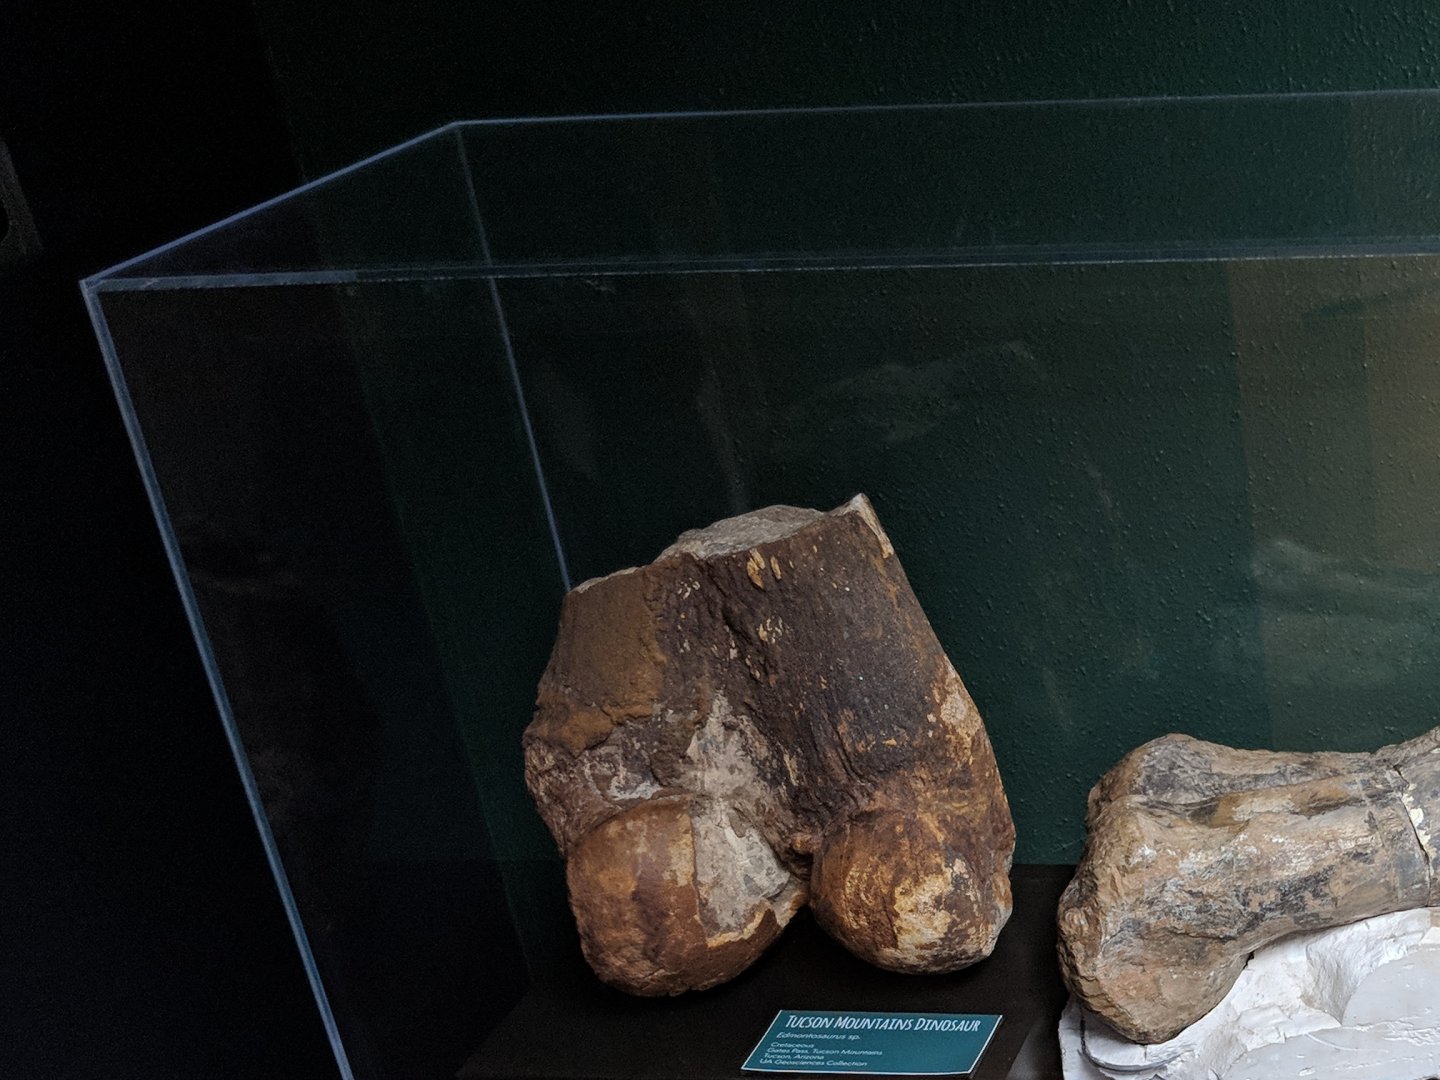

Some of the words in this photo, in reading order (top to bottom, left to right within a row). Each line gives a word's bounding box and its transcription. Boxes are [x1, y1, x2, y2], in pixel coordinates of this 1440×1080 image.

[785, 1015, 835, 1029] TUCSON
[833, 1016, 914, 1030] MOUNTAINS
[913, 1018, 981, 1032] DINOSAUR
[776, 1031, 847, 1040] Edmontosaurus
[847, 1033, 861, 1041] sp.
